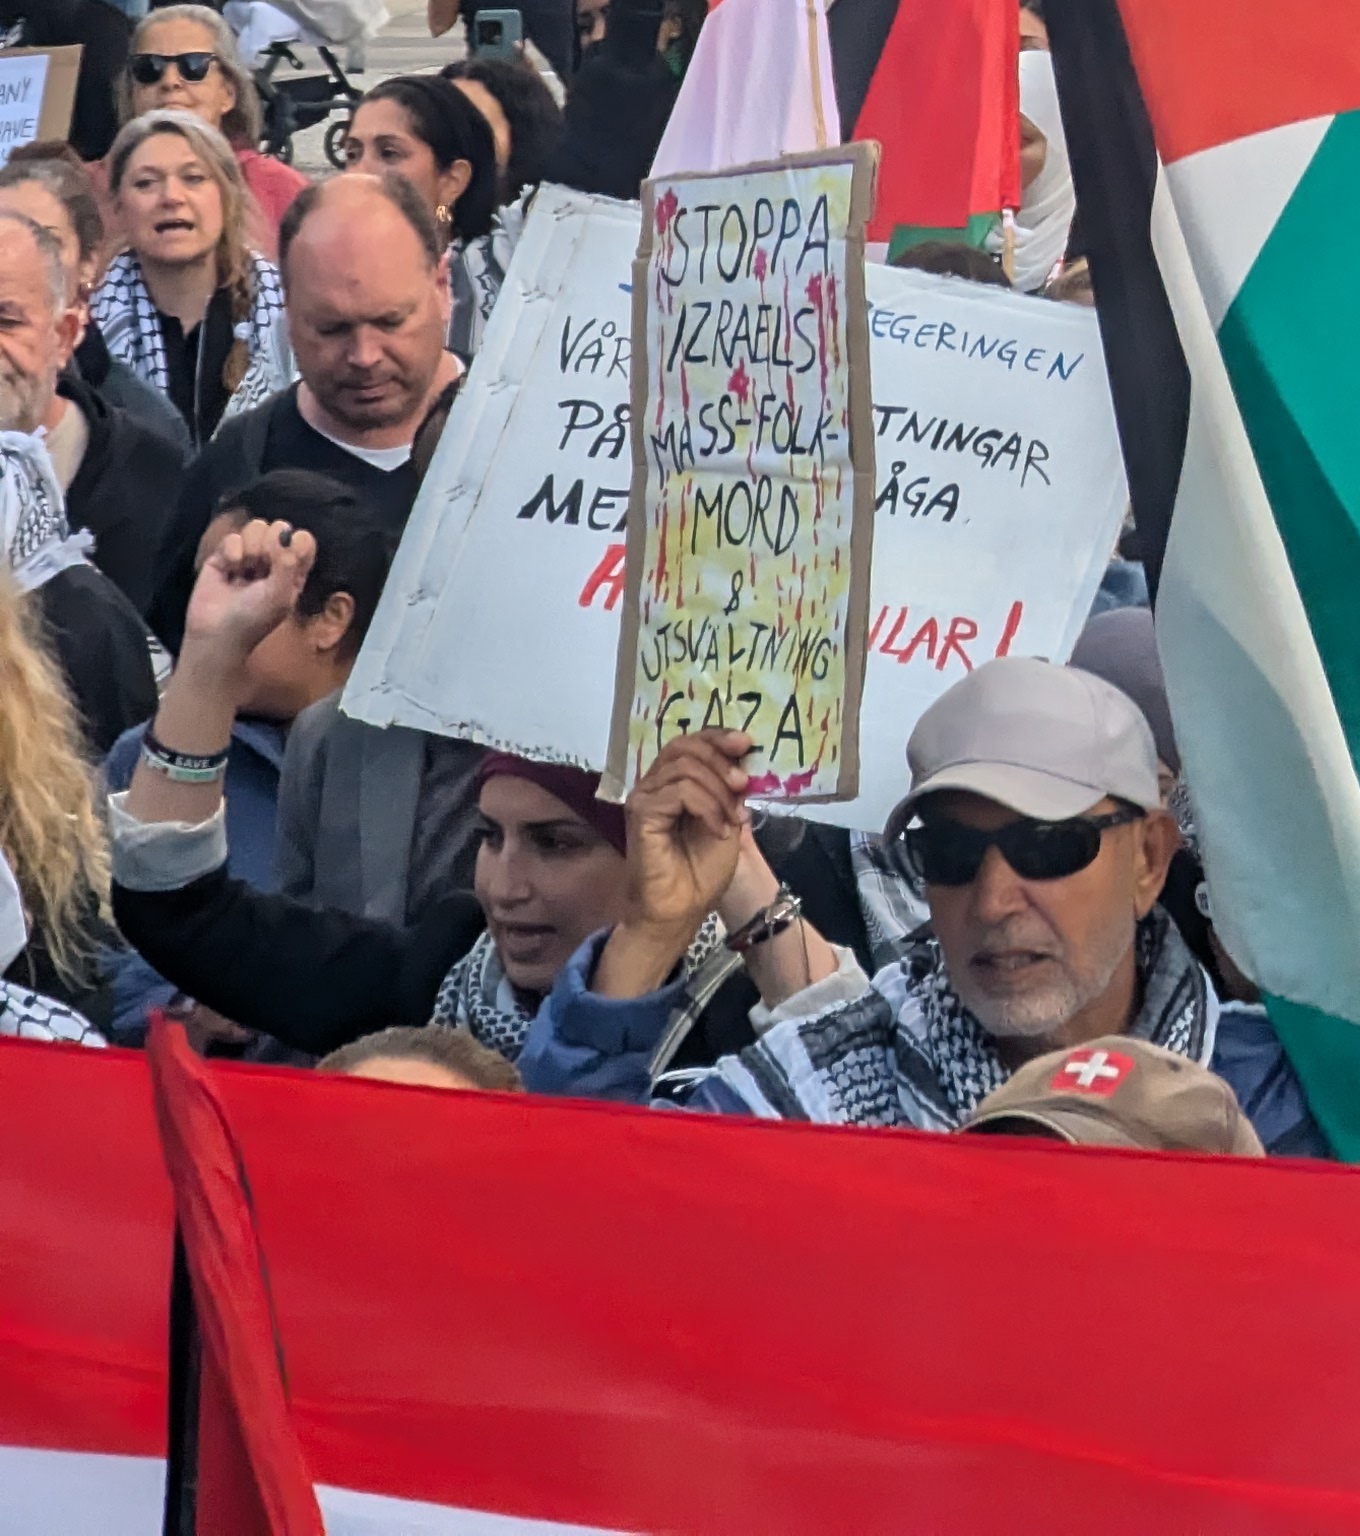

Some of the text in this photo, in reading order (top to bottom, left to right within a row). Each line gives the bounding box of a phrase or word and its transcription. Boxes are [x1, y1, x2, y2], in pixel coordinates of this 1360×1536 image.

[661, 194, 829, 287] STOPPA
[667, 300, 816, 374] IZRAELS
[866, 300, 1085, 382] EGERINGEN
[560, 315, 1051, 489] VÅR TNINGAR
[516, 473, 630, 533] ME
[691, 475, 800, 556] MORD
[641, 616, 832, 682] UTSVÄLTNING
